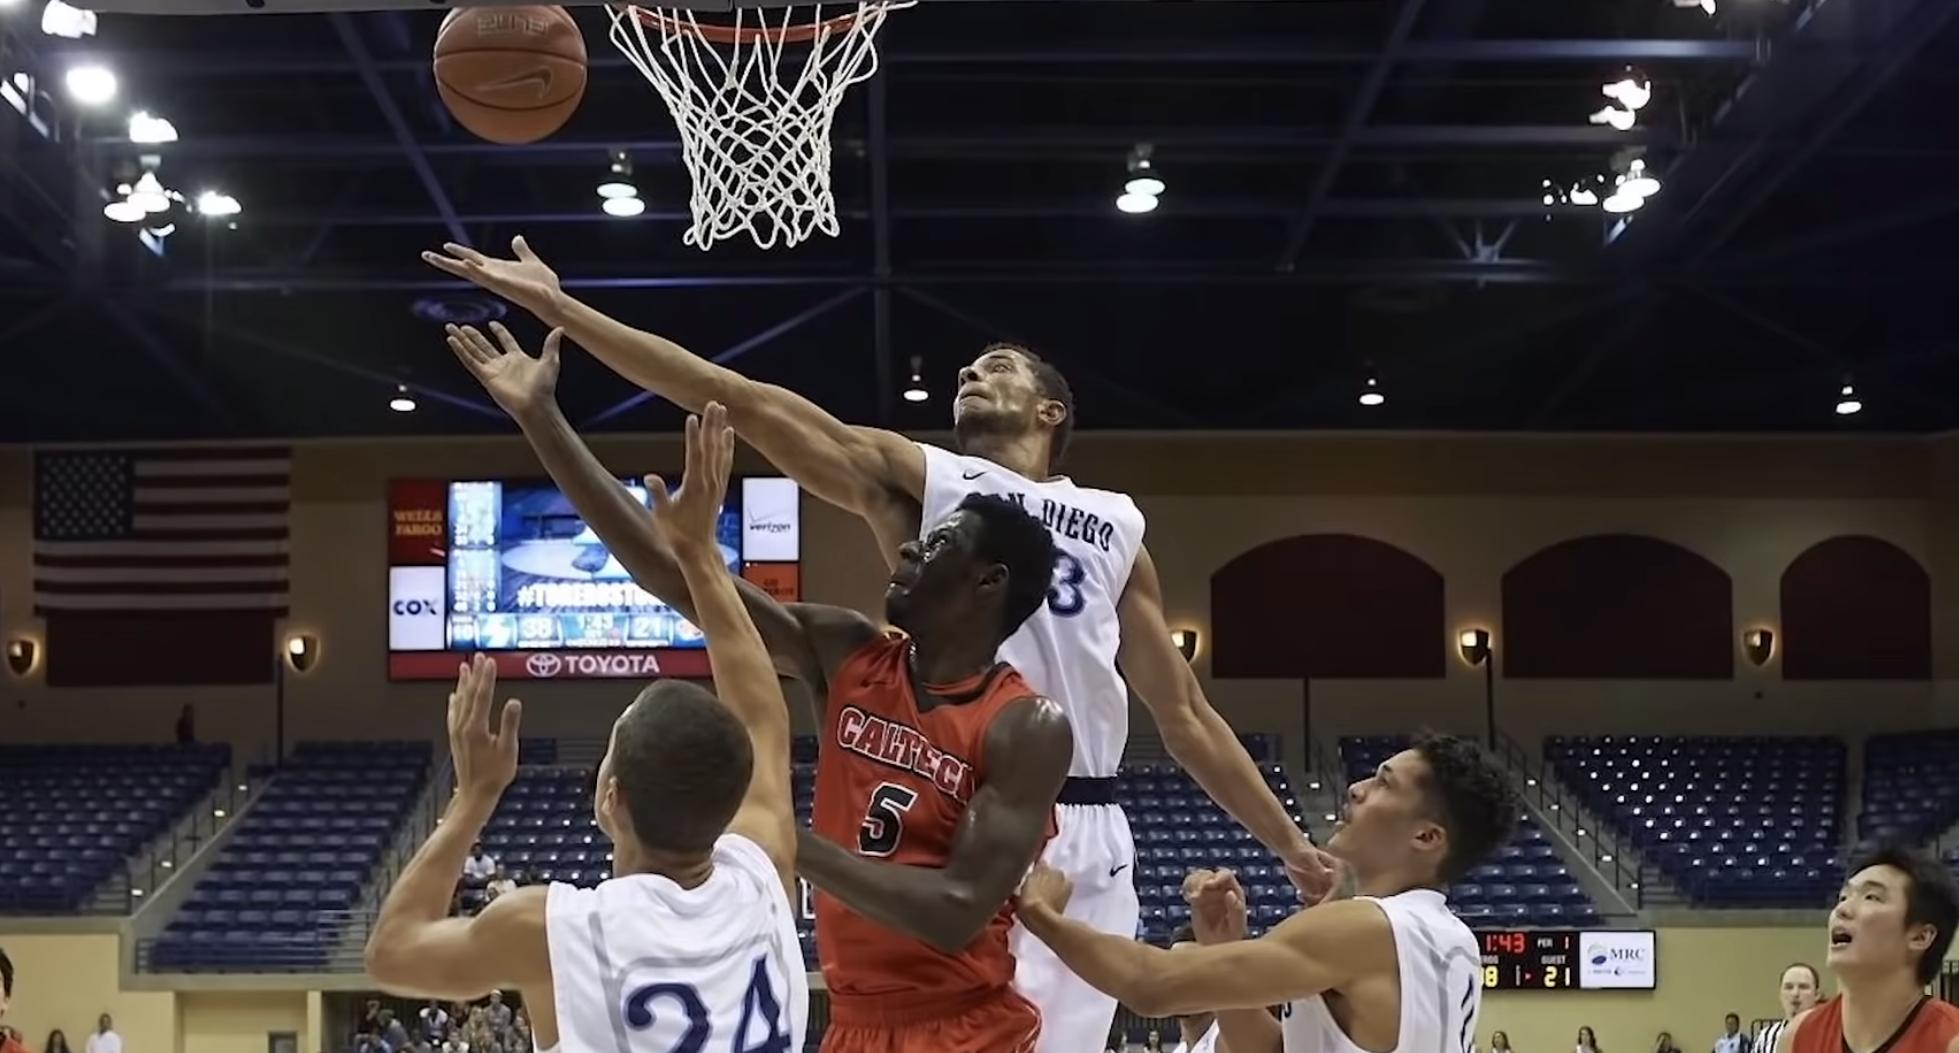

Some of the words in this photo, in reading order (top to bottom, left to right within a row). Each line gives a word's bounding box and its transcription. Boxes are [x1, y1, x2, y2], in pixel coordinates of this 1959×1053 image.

[750, 521, 791, 533] verizon
[1042, 499, 1114, 552] DIEGO
[394, 600, 437, 615] COX
[565, 655, 660, 673] TOYOTA
[857, 782, 918, 858] 5
[1486, 933, 1525, 953] 1:43
[1564, 936, 1569, 949] 1
[1541, 955, 1566, 964] GUEST
[1610, 948, 1645, 960] MRC
[1544, 965, 1571, 987] 21
[621, 953, 793, 1053] 24
